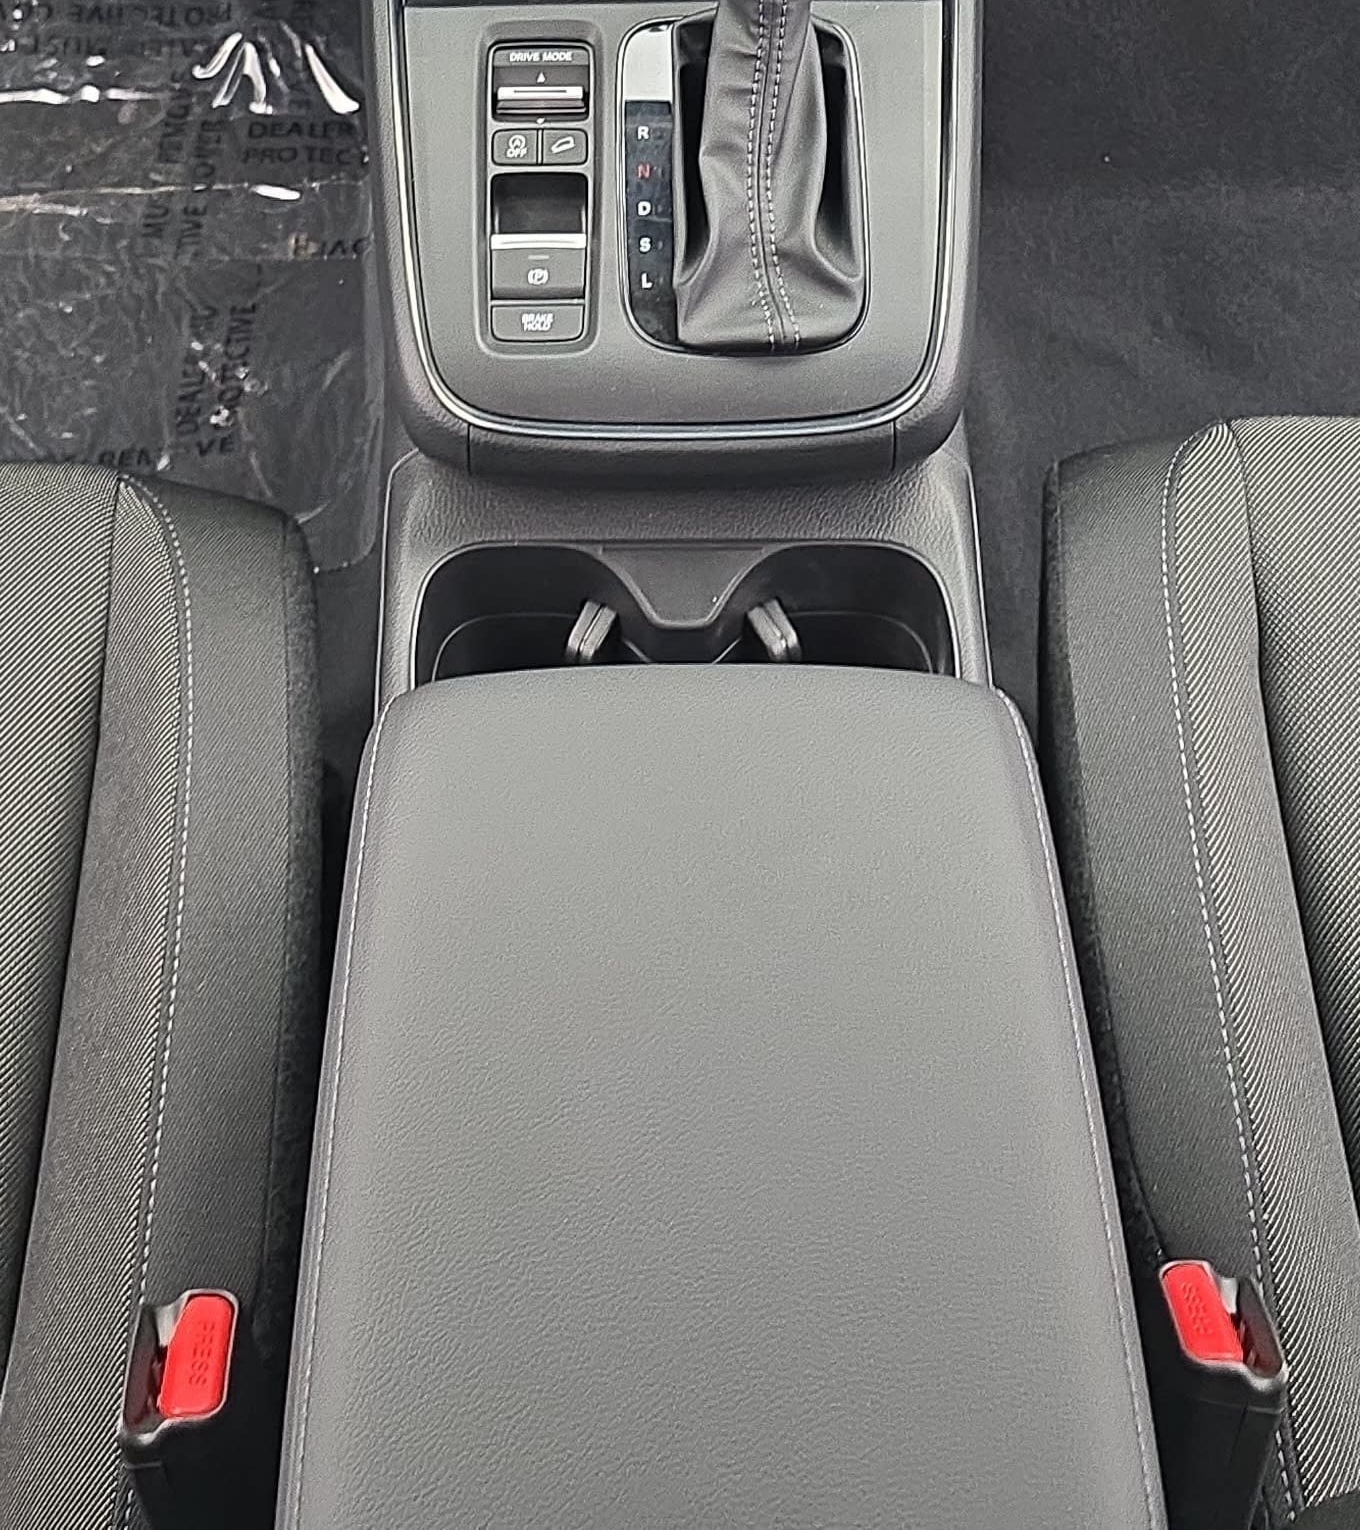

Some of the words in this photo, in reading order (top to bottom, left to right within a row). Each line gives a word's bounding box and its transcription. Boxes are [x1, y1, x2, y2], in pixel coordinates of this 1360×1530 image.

[509, 52, 540, 62] DRIVE
[542, 51, 573, 62] MODE
[638, 125, 650, 140] R
[506, 147, 528, 159] OFF
[638, 164, 651, 179] N
[637, 200, 652, 216] D
[639, 237, 652, 252] S
[641, 273, 653, 289] L
